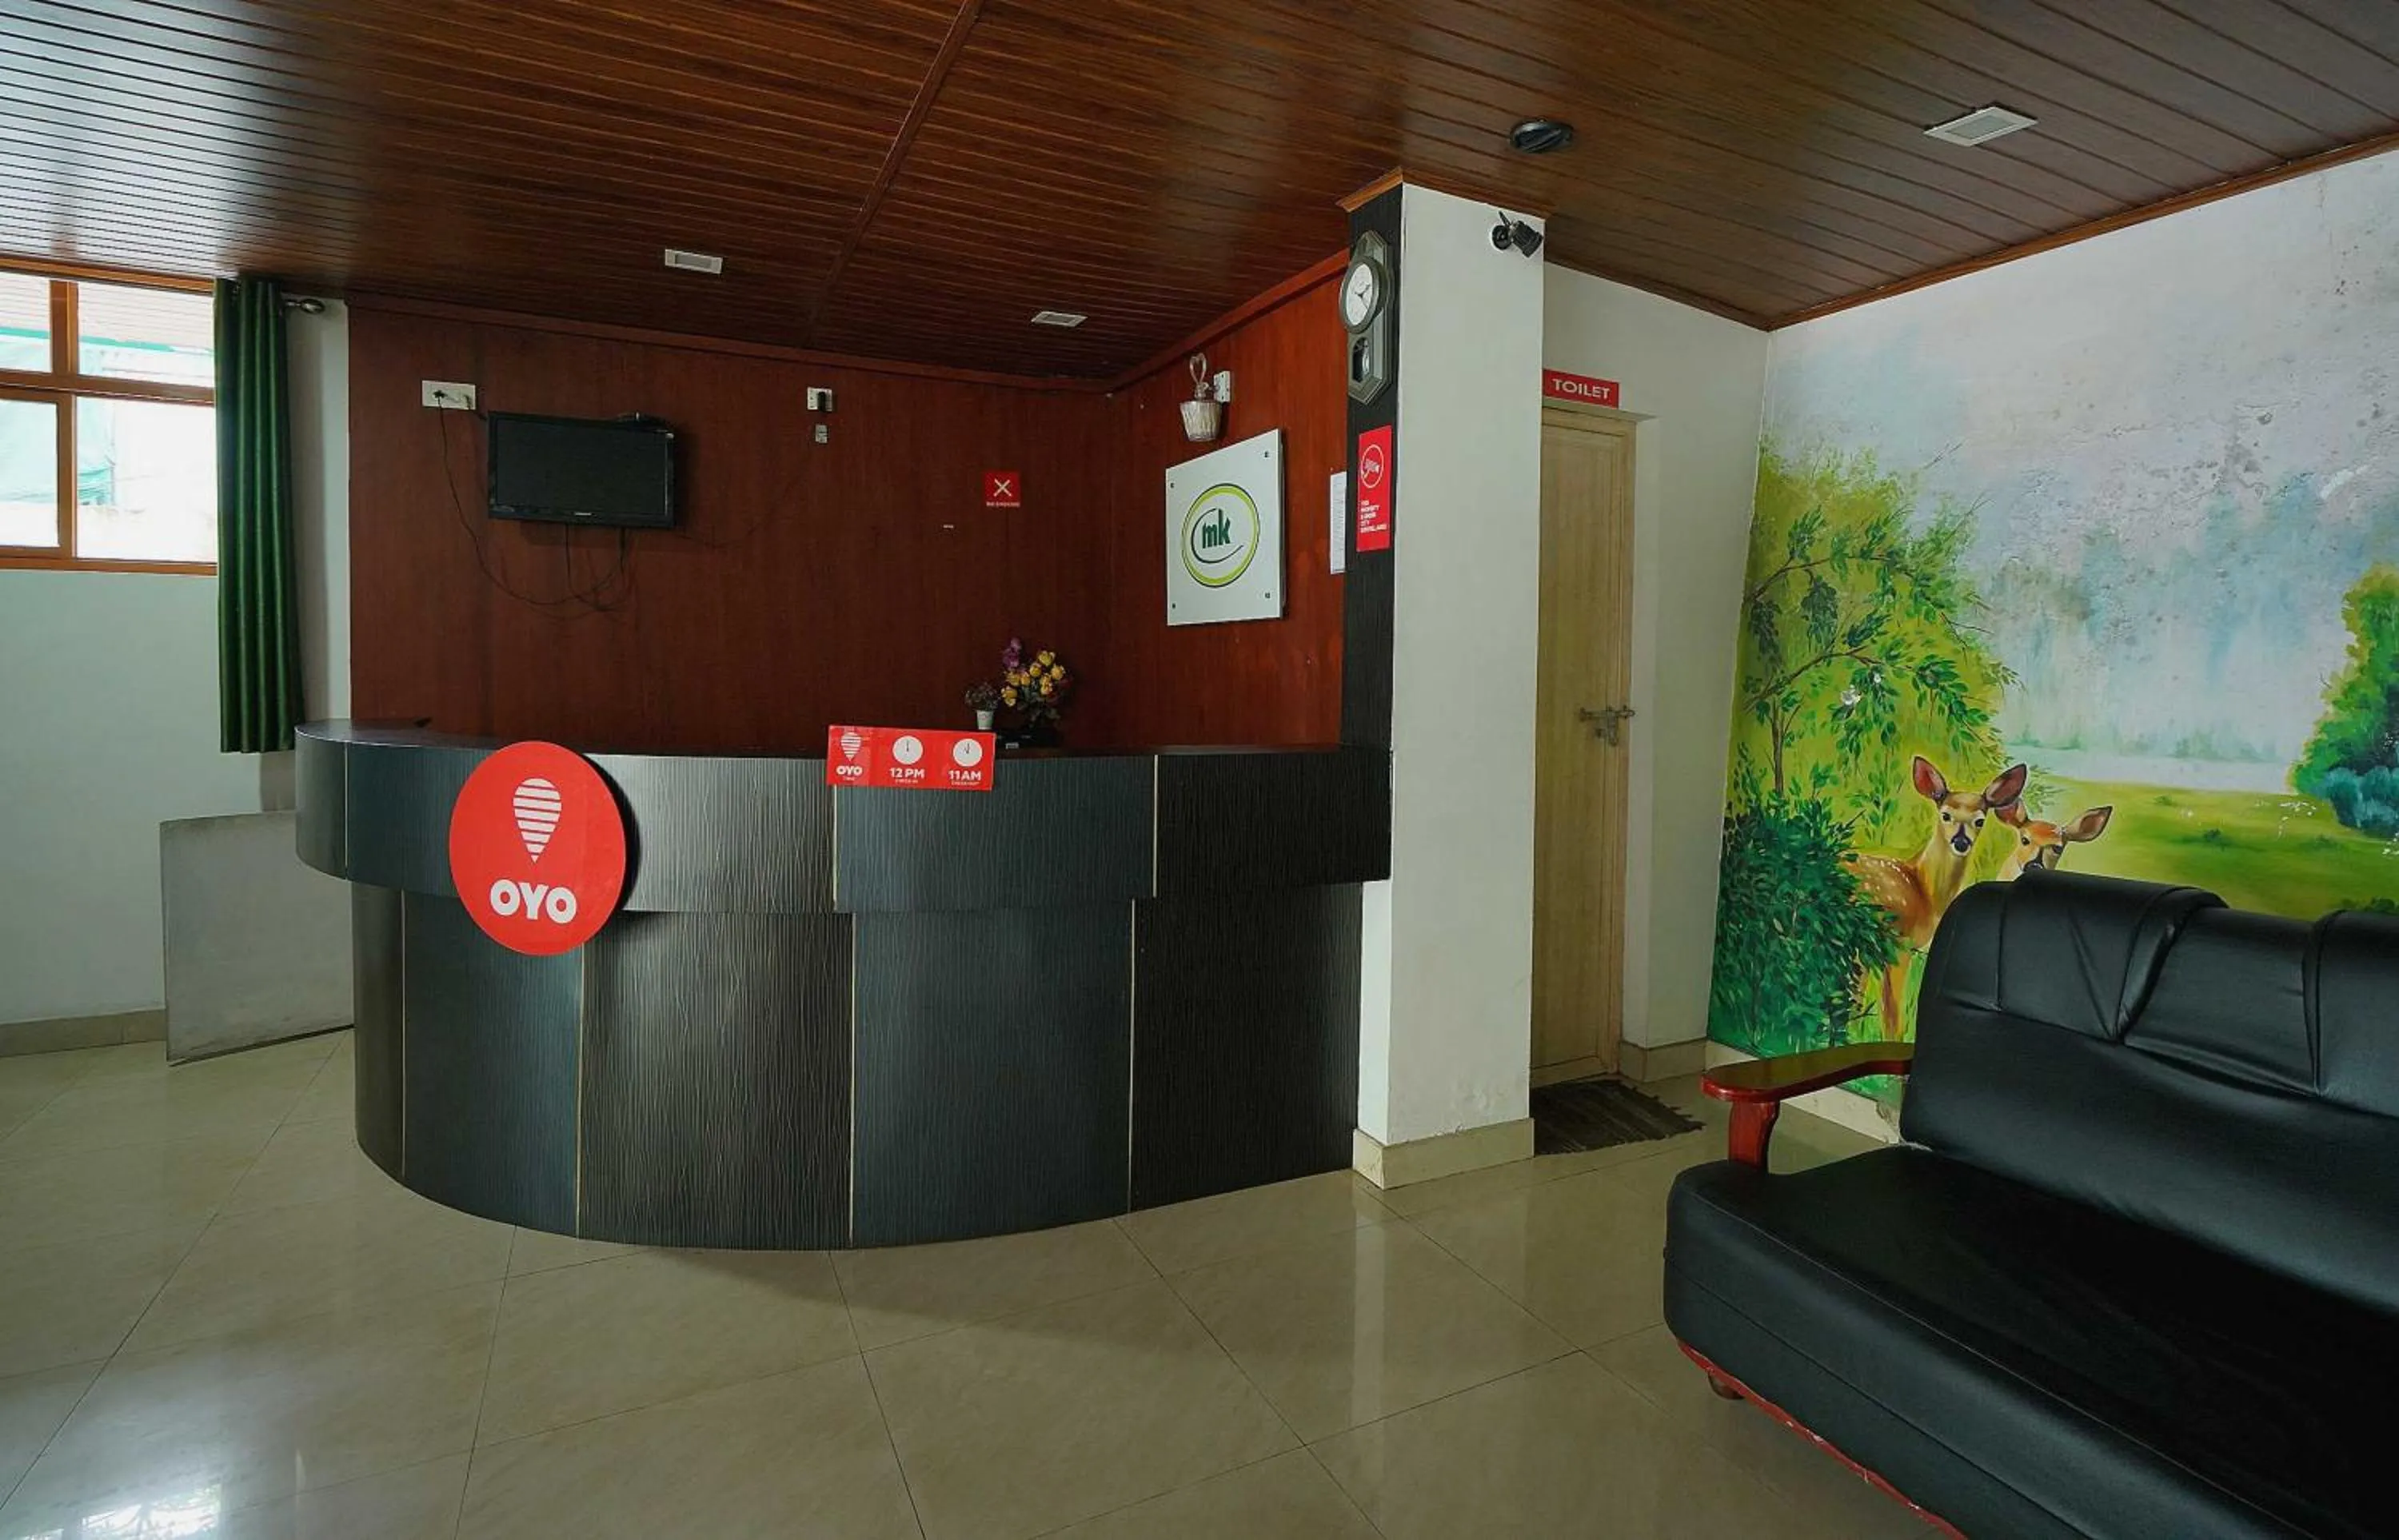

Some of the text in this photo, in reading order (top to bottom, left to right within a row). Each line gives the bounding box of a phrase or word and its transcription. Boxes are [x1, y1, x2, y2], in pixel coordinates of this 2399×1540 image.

[1552, 379, 1610, 399] TOILET
[1202, 509, 1231, 548] mk
[836, 765, 863, 776] OYO
[889, 768, 924, 779] 12 PM
[490, 880, 577, 924] OYO
